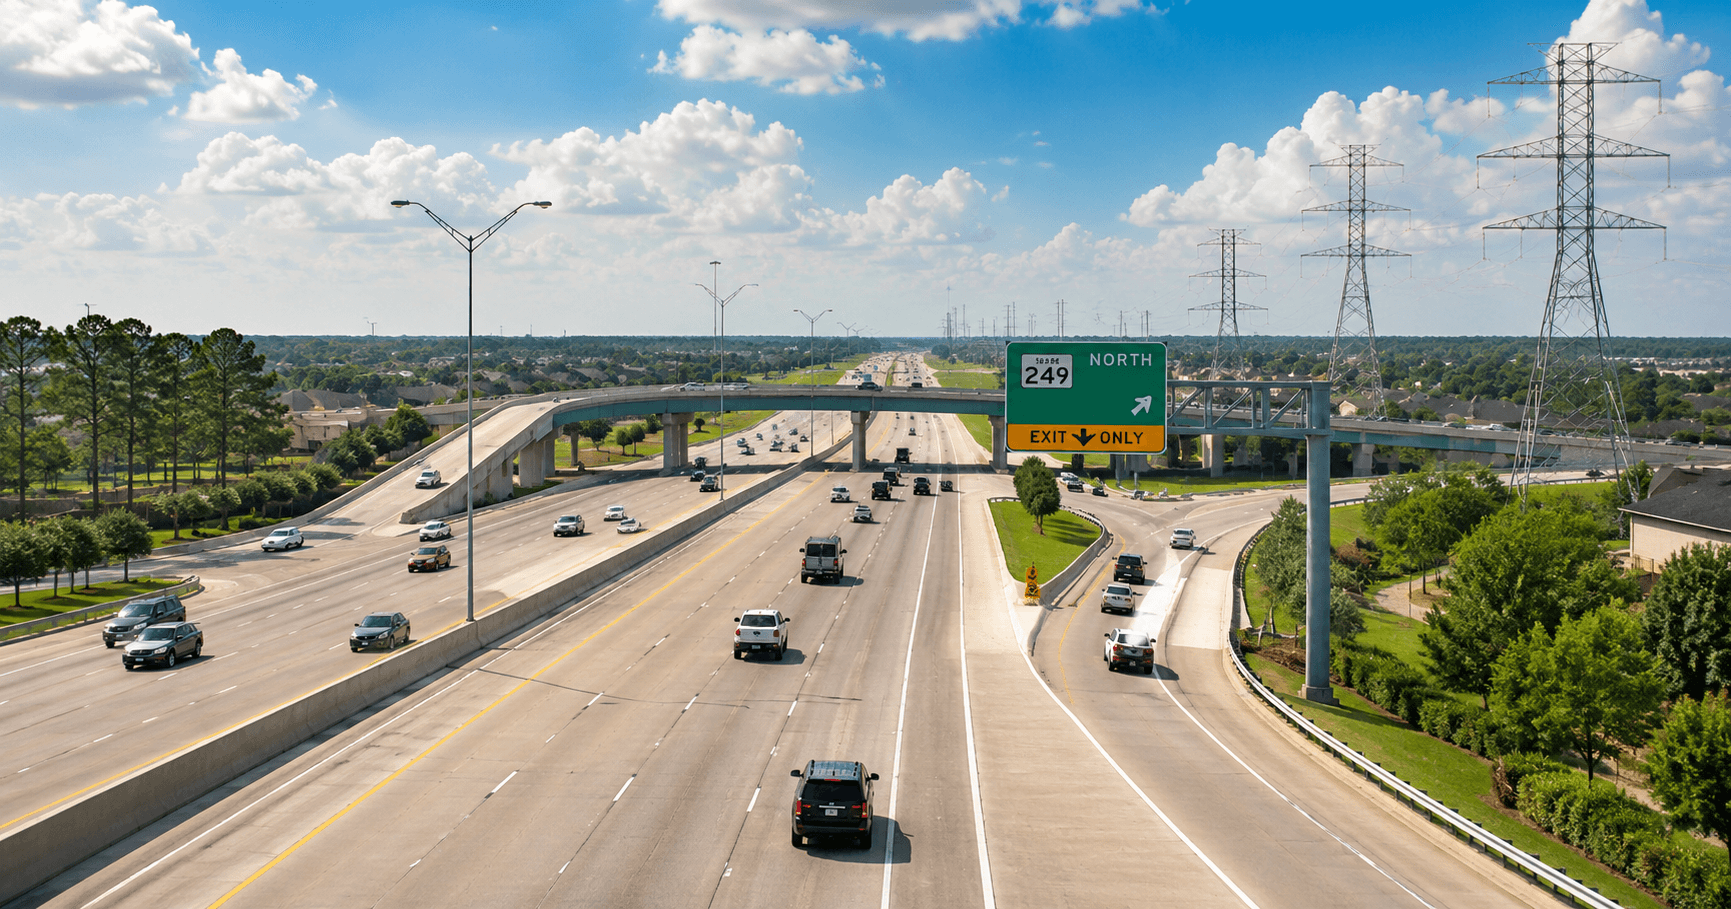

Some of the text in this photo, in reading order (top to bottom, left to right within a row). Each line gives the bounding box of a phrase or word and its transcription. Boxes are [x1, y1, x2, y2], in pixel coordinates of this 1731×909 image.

[1090, 353, 1152, 366] NORTH
[1025, 366, 1069, 384] 249
[1030, 430, 1143, 444] EXIT ONLY
